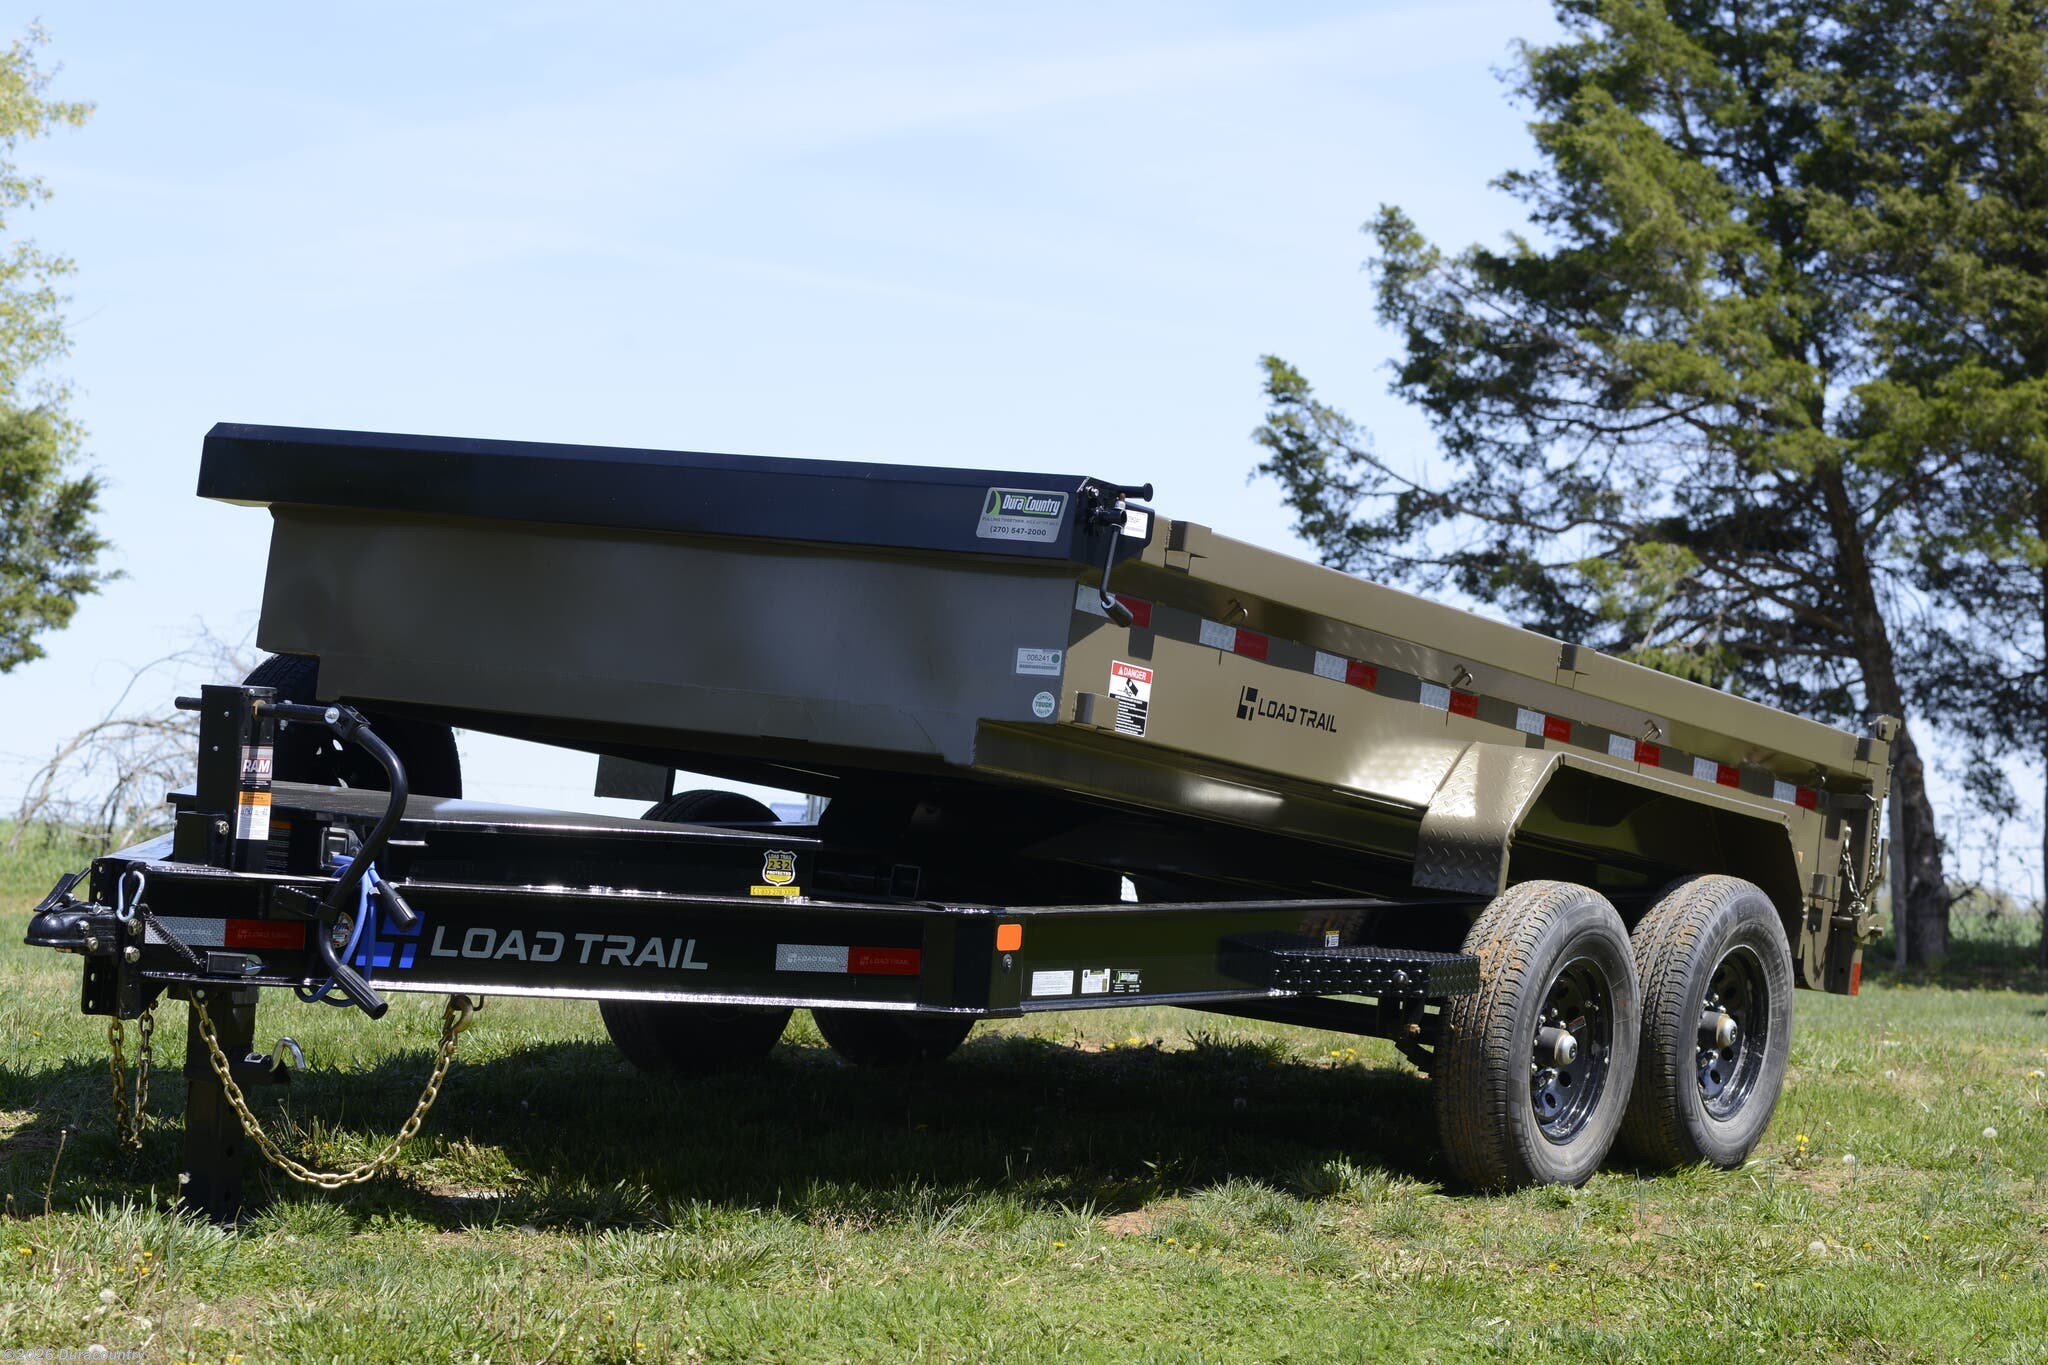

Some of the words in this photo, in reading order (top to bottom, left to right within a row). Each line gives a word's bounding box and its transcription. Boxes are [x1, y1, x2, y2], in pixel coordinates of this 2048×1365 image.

[1002, 494, 1024, 510] Dura
[1025, 496, 1061, 515] Country
[990, 525, 1009, 534] (270)
[1011, 527, 1047, 536] 547-2000
[1123, 667, 1147, 681] DANGER
[1258, 698, 1297, 723] LOAD
[1300, 708, 1337, 733] TRAIL
[242, 759, 271, 773] RAM
[769, 860, 790, 870] 232
[430, 925, 565, 962] LOAD
[574, 933, 709, 970] TRAIL
